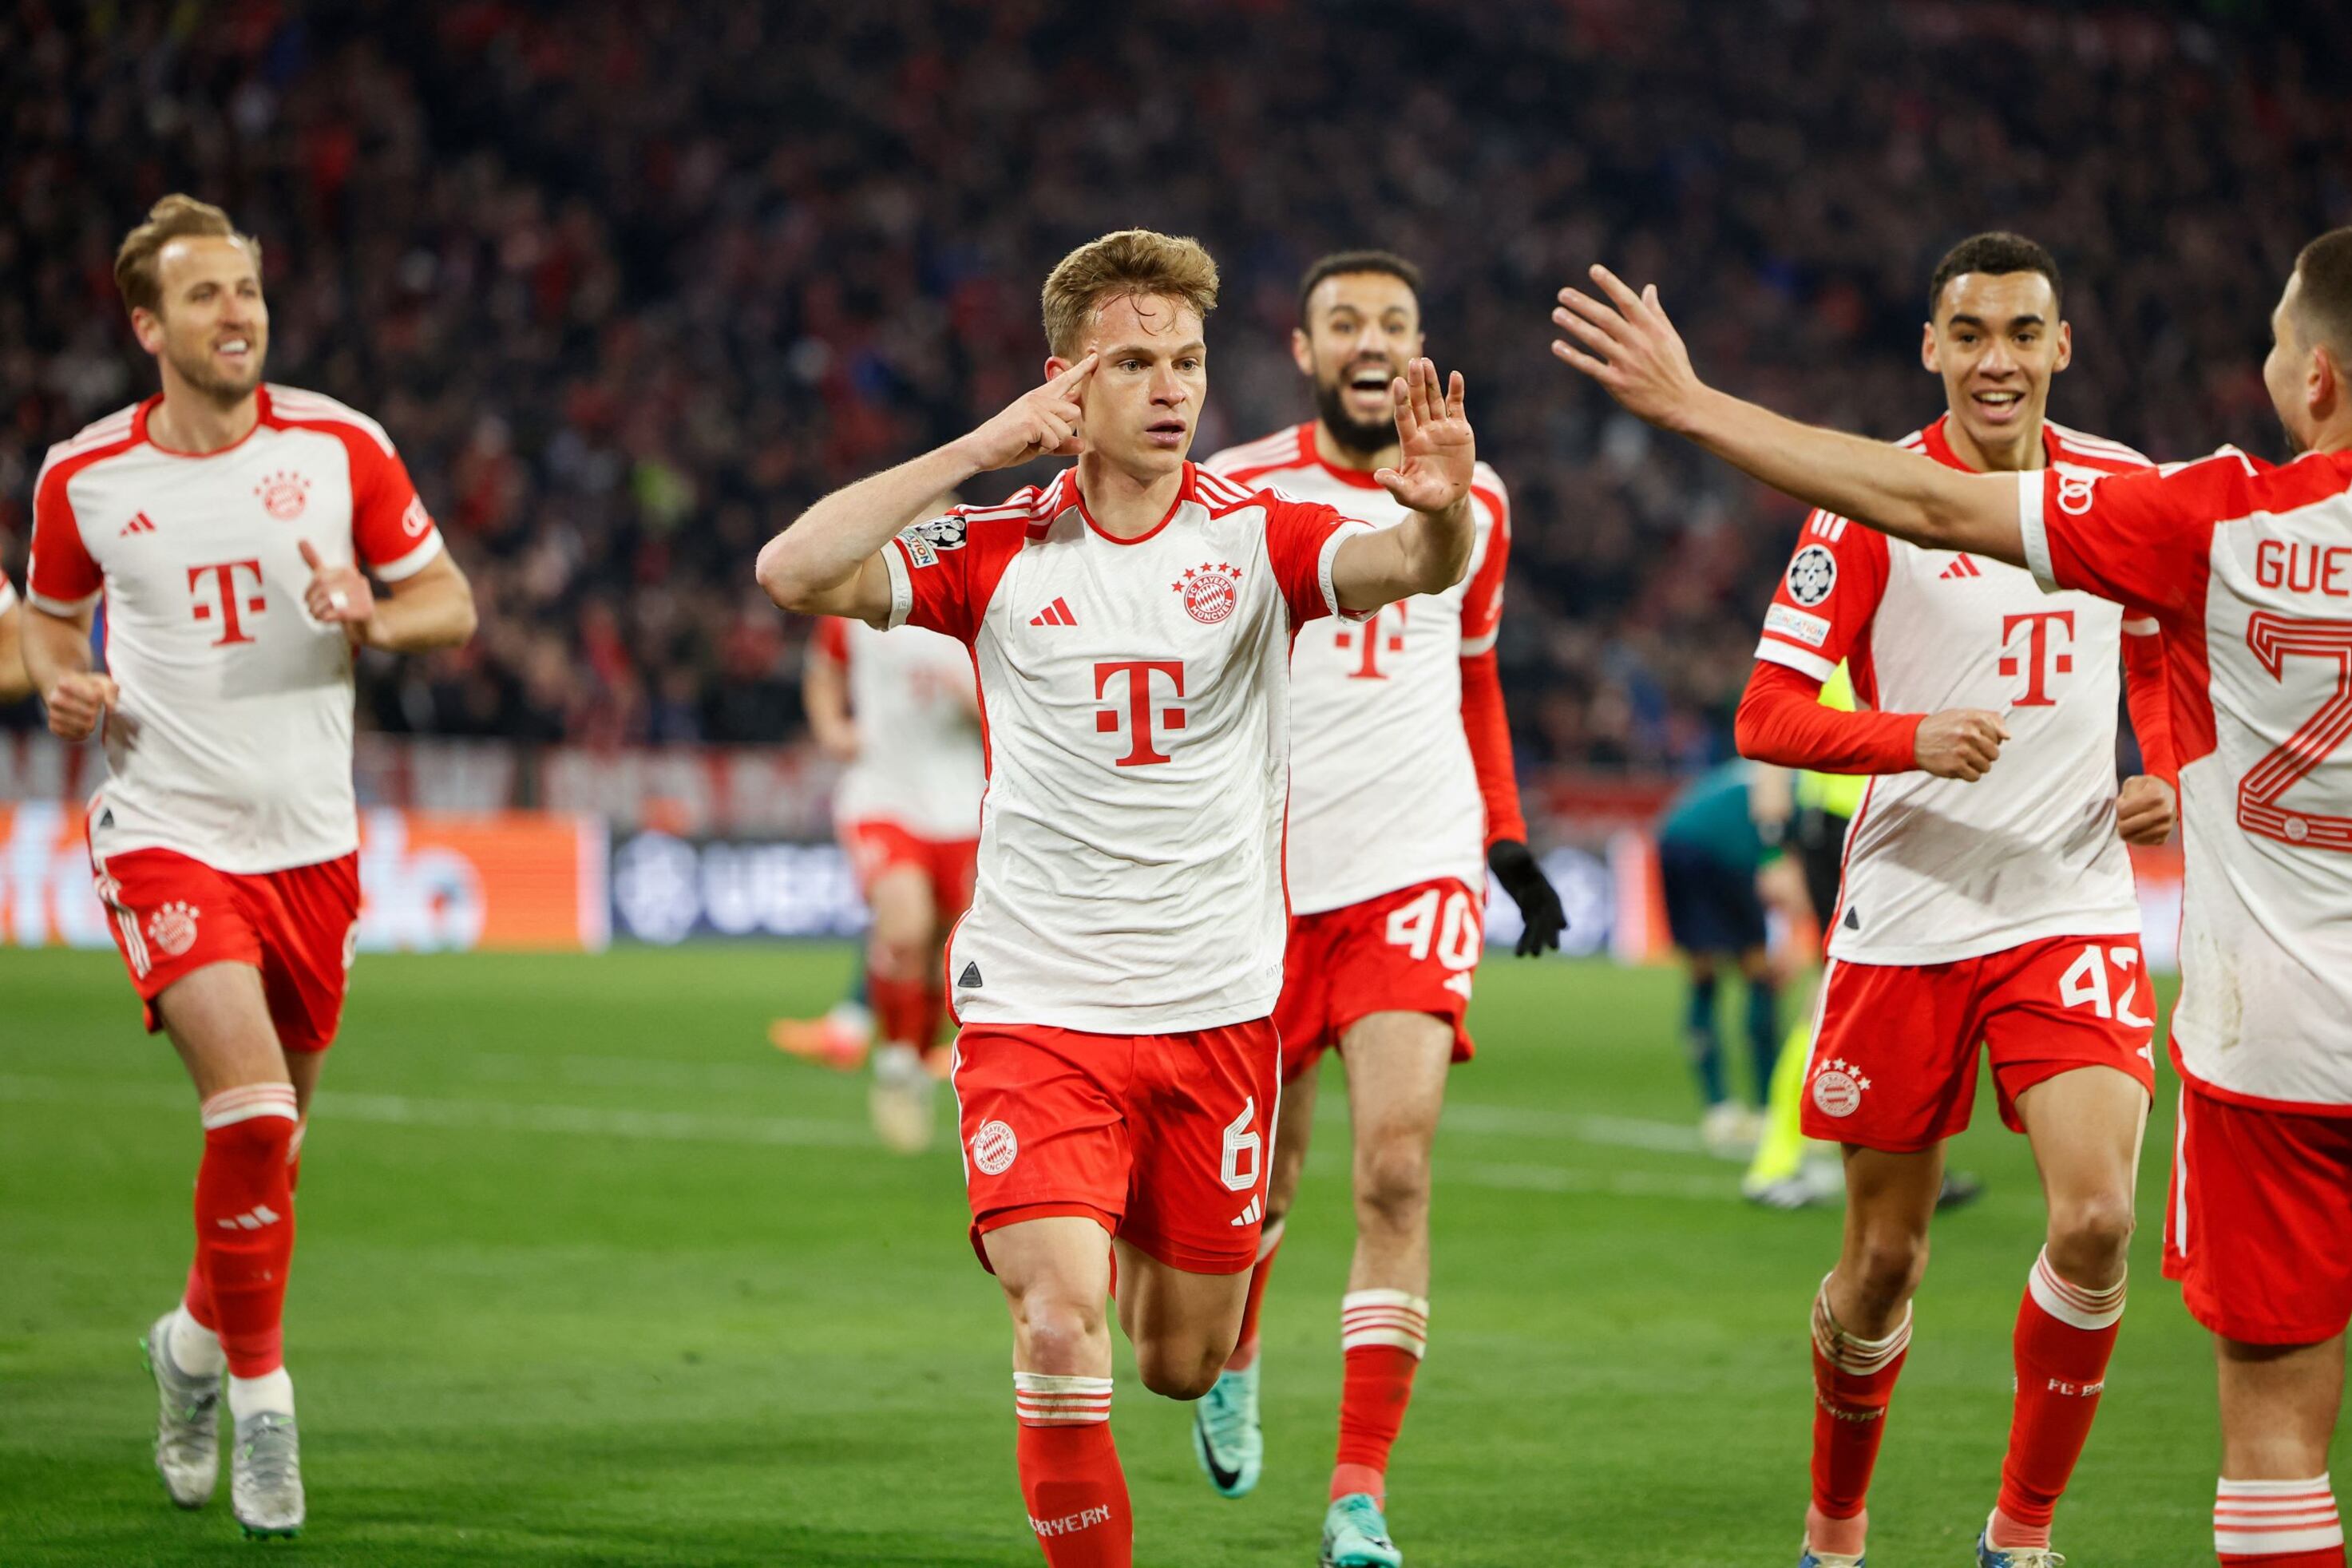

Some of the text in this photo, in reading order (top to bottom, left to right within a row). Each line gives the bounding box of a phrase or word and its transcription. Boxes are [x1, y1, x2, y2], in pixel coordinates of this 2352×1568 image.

[188, 559, 266, 647] T
[1188, 576, 1230, 599] FC BAYERN
[2256, 539, 2352, 597] GUE
[1998, 610, 2074, 707] T
[1094, 661, 1186, 766] T
[1385, 889, 1480, 971] 40
[2058, 944, 2155, 1028] 42
[984, 1125, 1011, 1140] BAYERN
[1221, 1096, 1261, 1192] 6
